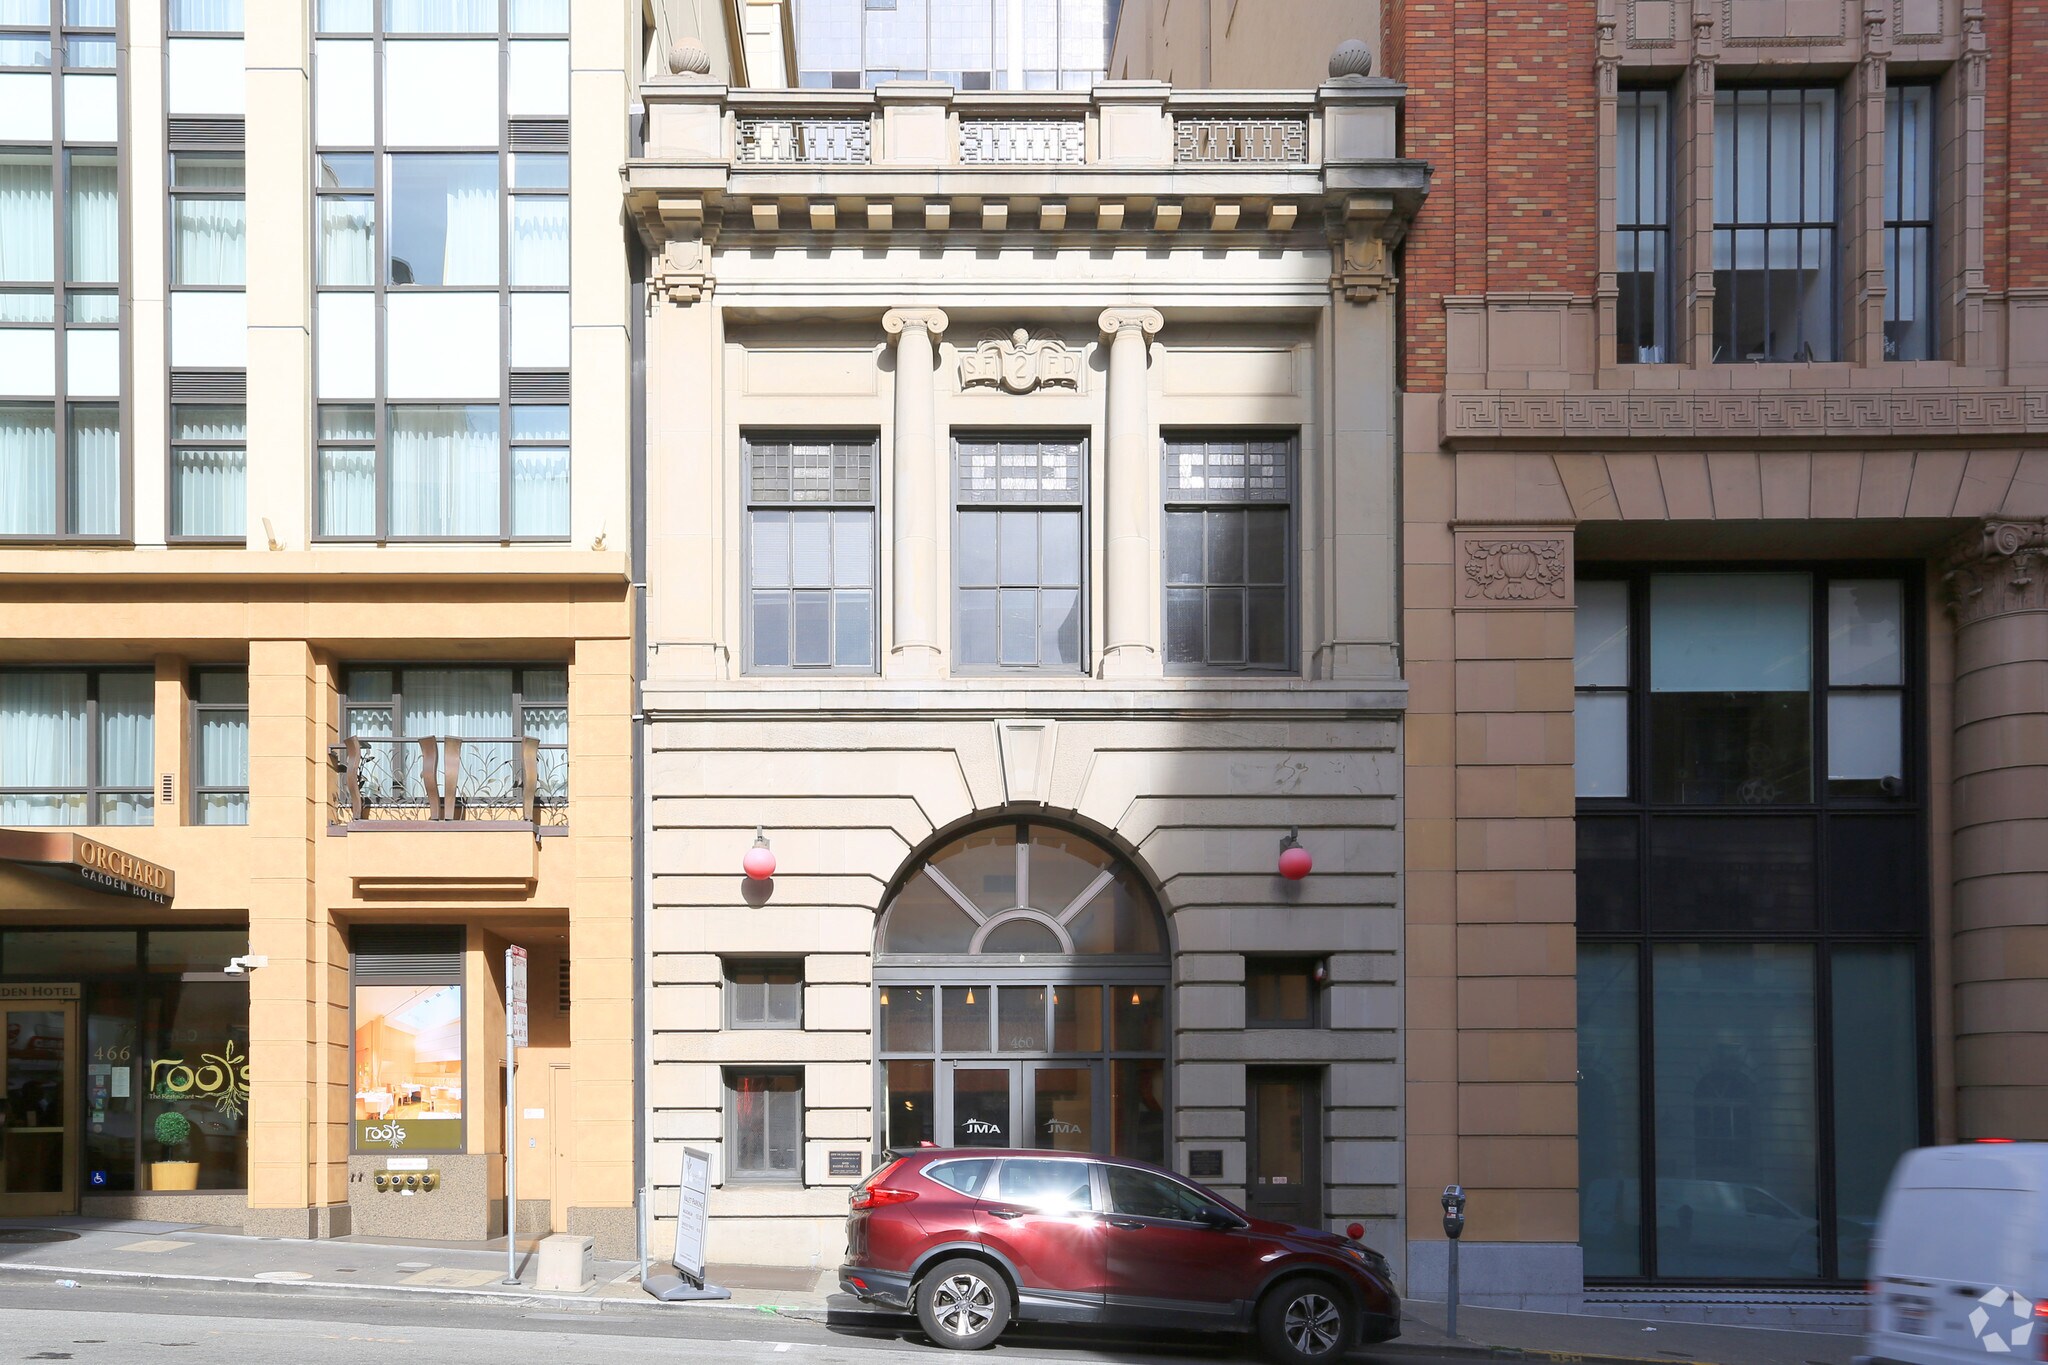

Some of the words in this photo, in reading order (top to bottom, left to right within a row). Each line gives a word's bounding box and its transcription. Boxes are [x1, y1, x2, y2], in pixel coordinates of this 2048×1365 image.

[1014, 355, 1027, 379] 2
[81, 841, 167, 889] ORCHARD
[81, 867, 127, 892] GARDEN
[133, 885, 165, 904] HOTEL
[0, 987, 28, 997] DEN
[32, 986, 77, 997] HOTEL
[1011, 1037, 1034, 1049] 460
[94, 1045, 131, 1061] 466
[365, 1120, 407, 1144] roots
[966, 1123, 1001, 1134] JMA
[1047, 1123, 1082, 1134] JMA
